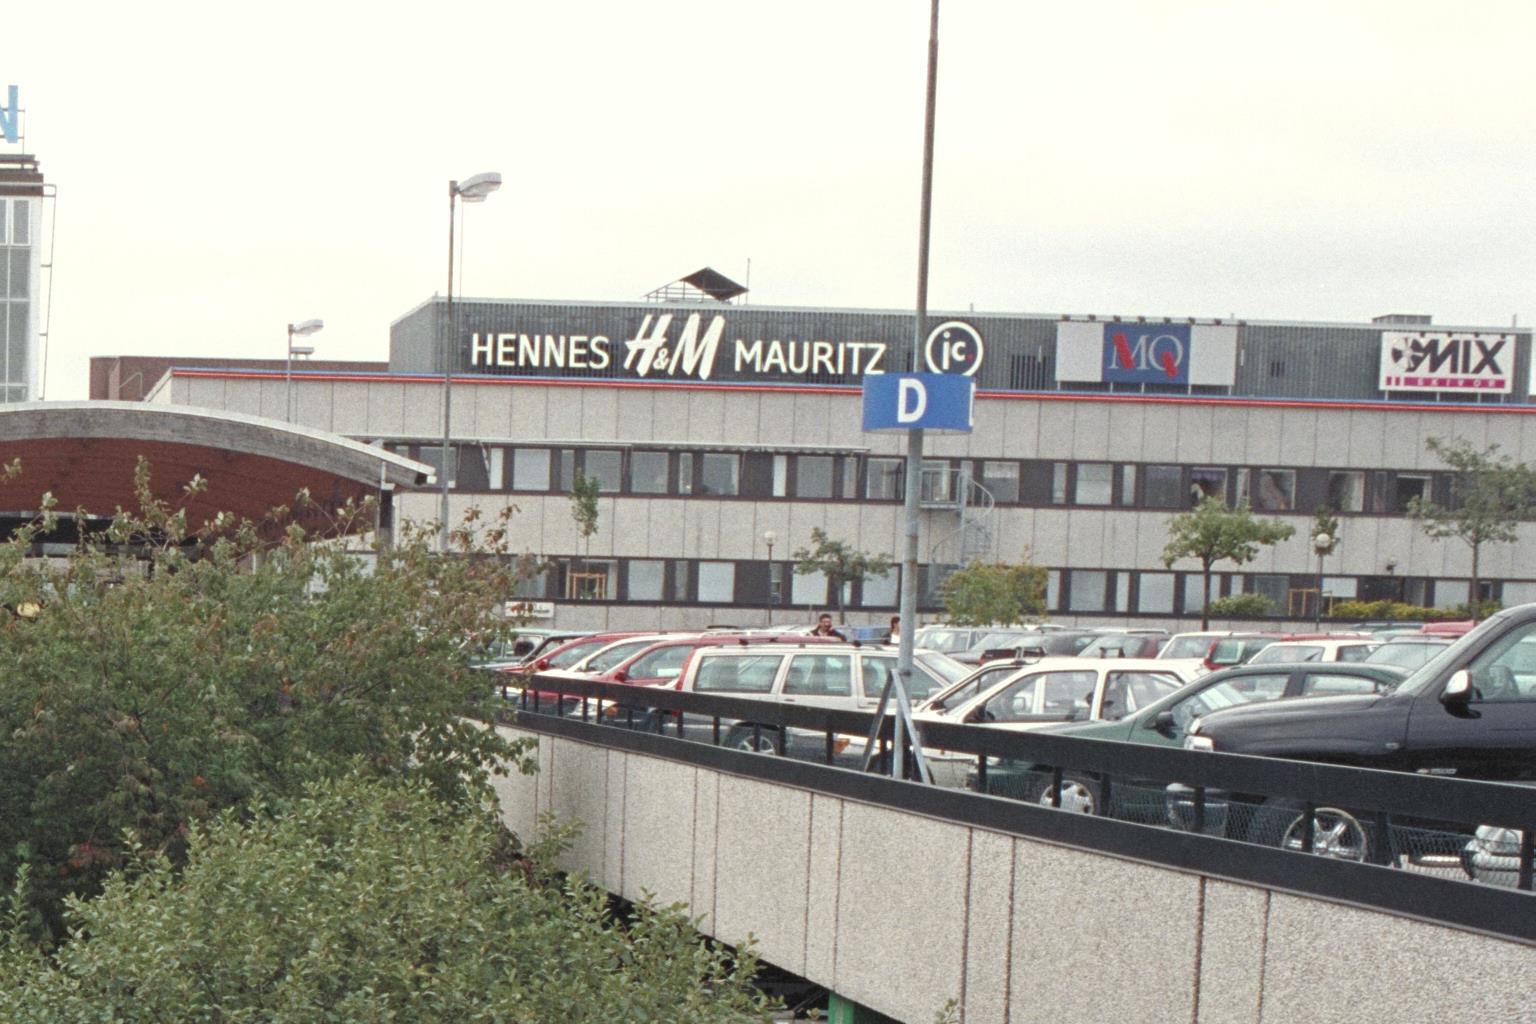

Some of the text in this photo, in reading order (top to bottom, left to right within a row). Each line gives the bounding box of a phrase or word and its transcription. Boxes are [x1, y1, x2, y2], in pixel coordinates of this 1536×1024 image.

[470, 332, 611, 370] HENNES
[733, 338, 887, 375] MAURITZ
[1110, 332, 1184, 378] MQ
[897, 377, 927, 424] D
